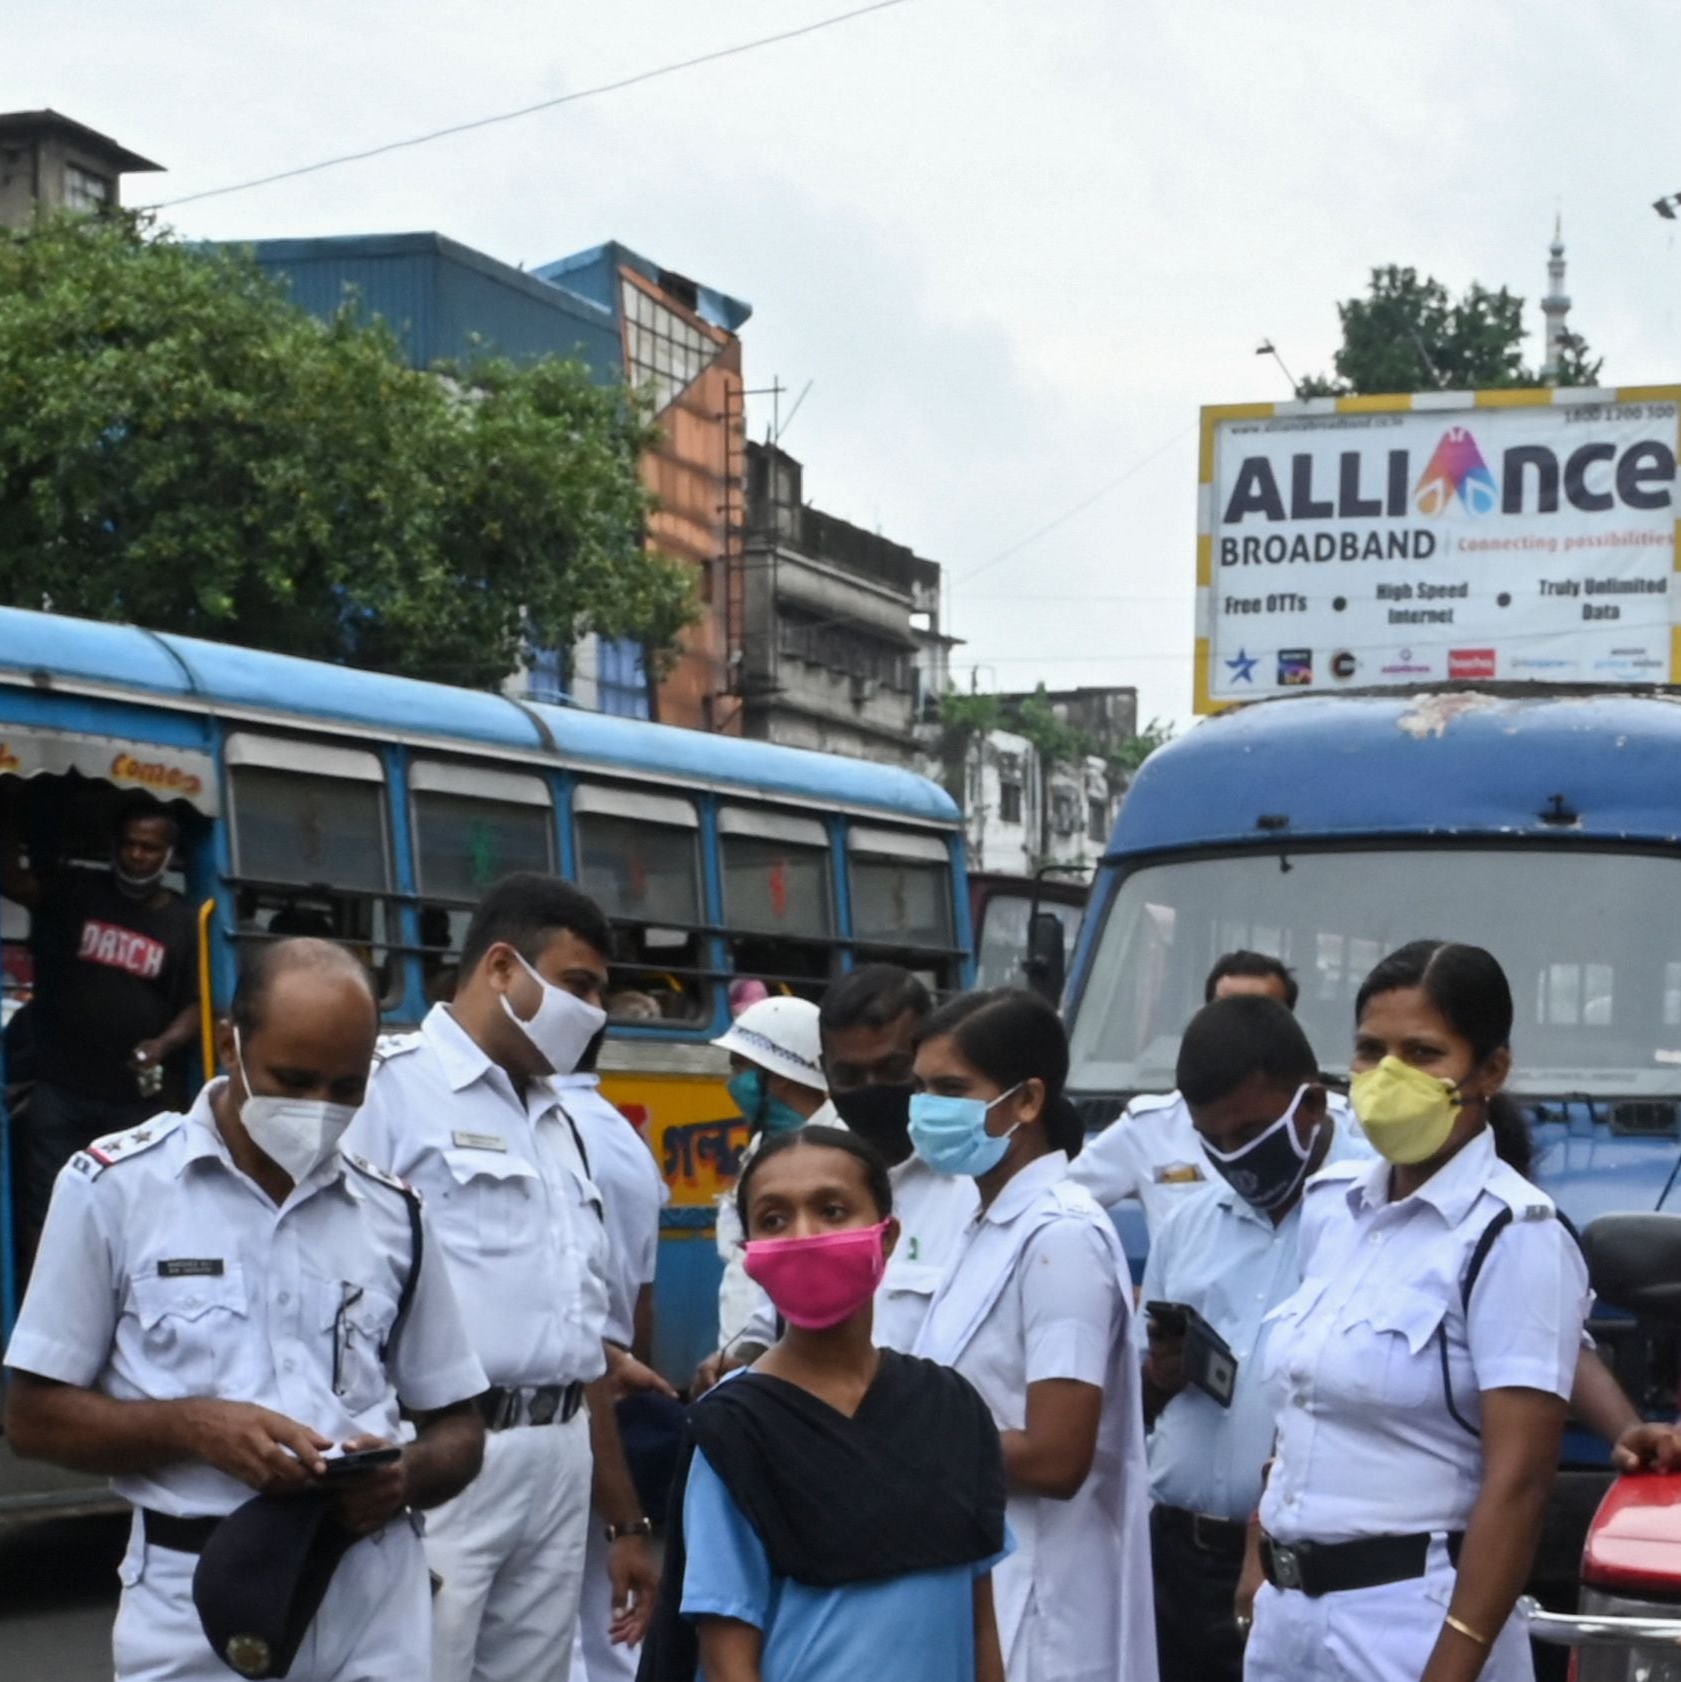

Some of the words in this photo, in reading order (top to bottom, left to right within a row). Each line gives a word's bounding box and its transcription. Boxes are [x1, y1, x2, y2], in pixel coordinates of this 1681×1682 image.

[1220, 529, 1436, 566] BROADBAND
[1458, 534, 1558, 554] Connecting
[1564, 530, 1674, 551] possibilities
[1376, 583, 1413, 601] High
[1417, 581, 1468, 601] Speed
[1539, 578, 1581, 598] Truly
[1584, 576, 1668, 596] Unlimited
[1225, 596, 1262, 615] Free
[1266, 592, 1308, 613] OTTs
[1582, 603, 1620, 621] Data
[1387, 607, 1454, 625] Internet
